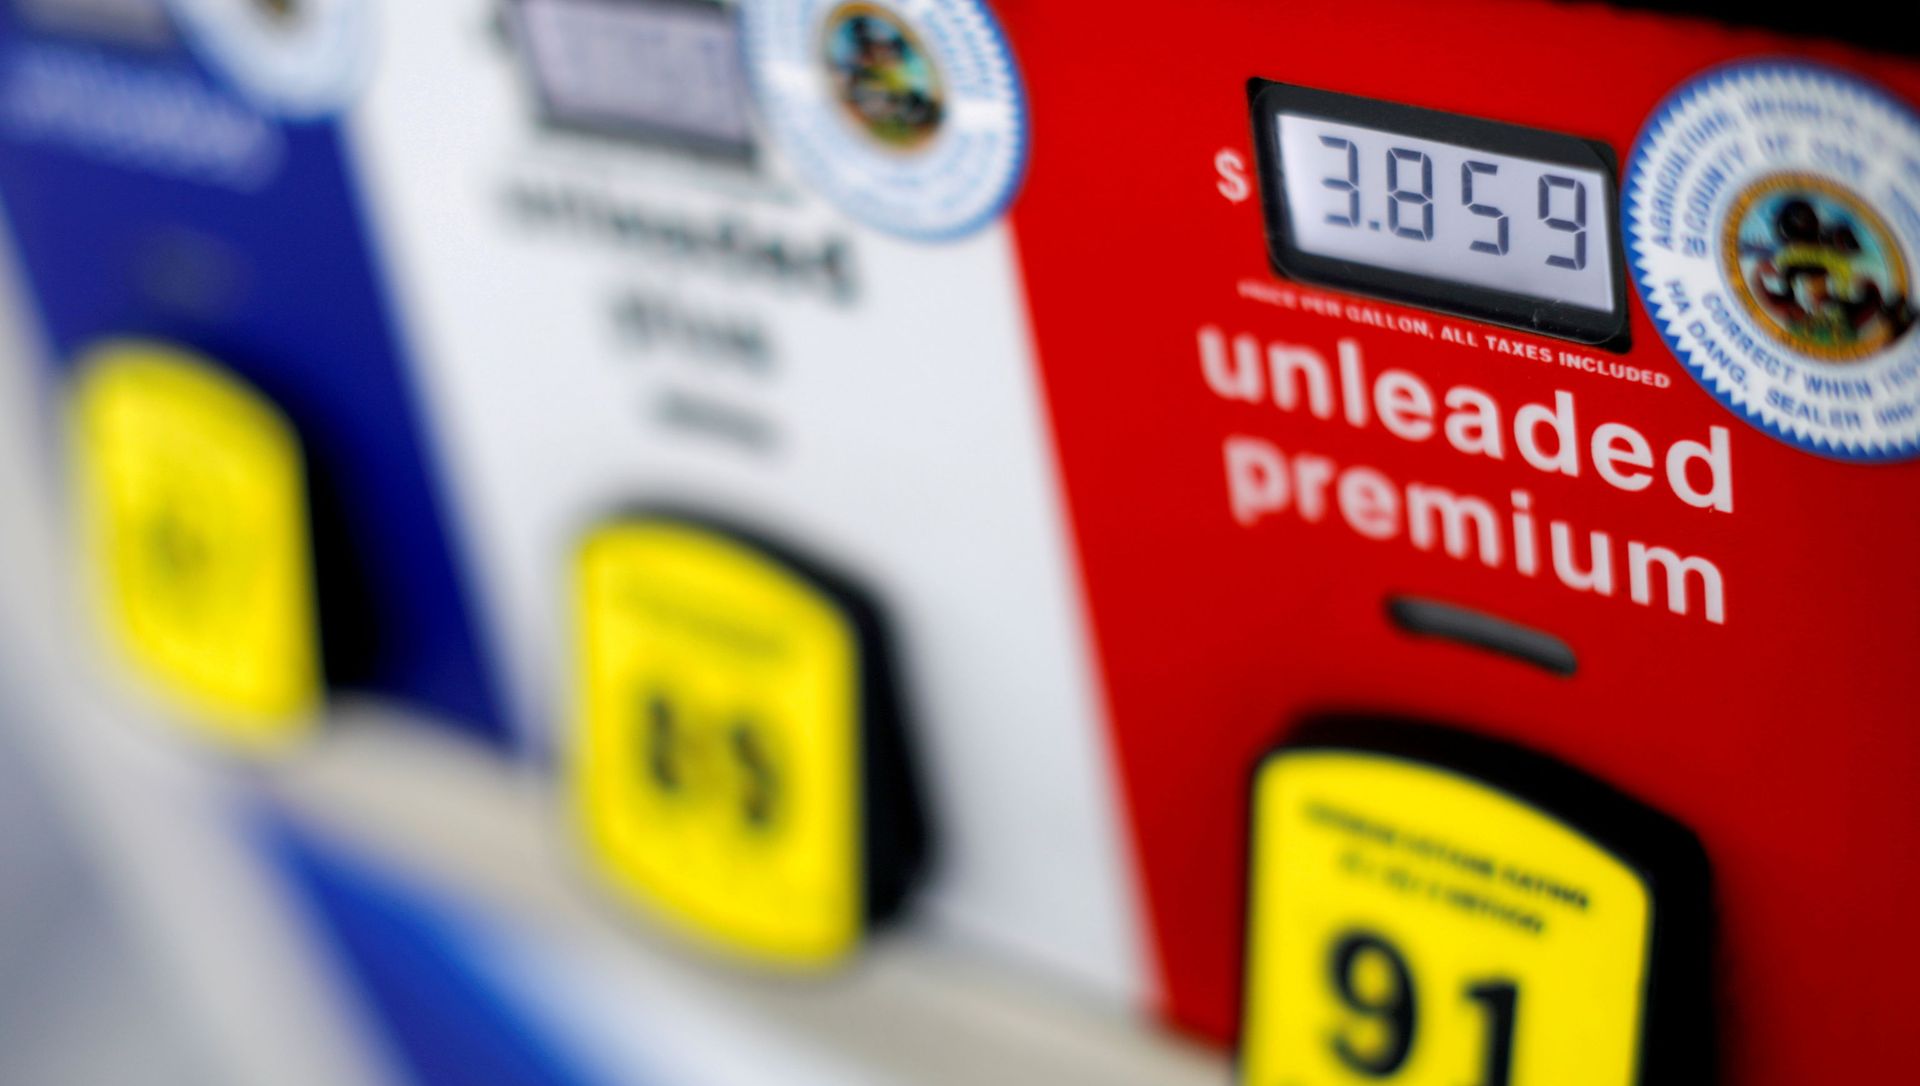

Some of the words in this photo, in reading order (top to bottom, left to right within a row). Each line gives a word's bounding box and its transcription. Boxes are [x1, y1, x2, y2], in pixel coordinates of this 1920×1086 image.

[1213, 148, 1250, 204] $
[1318, 134, 1587, 271] 3.859
[1300, 295, 1341, 318] PER
[1345, 304, 1434, 340] GALLON,
[1440, 325, 1479, 347] ALL
[1485, 334, 1553, 363] TAXES
[1558, 350, 1671, 389] INCLUDED
[1702, 290, 1796, 385] CORRECT
[1198, 326, 1734, 513] unleaded
[1223, 434, 1725, 625] premium
[1328, 924, 1518, 1086] 91
